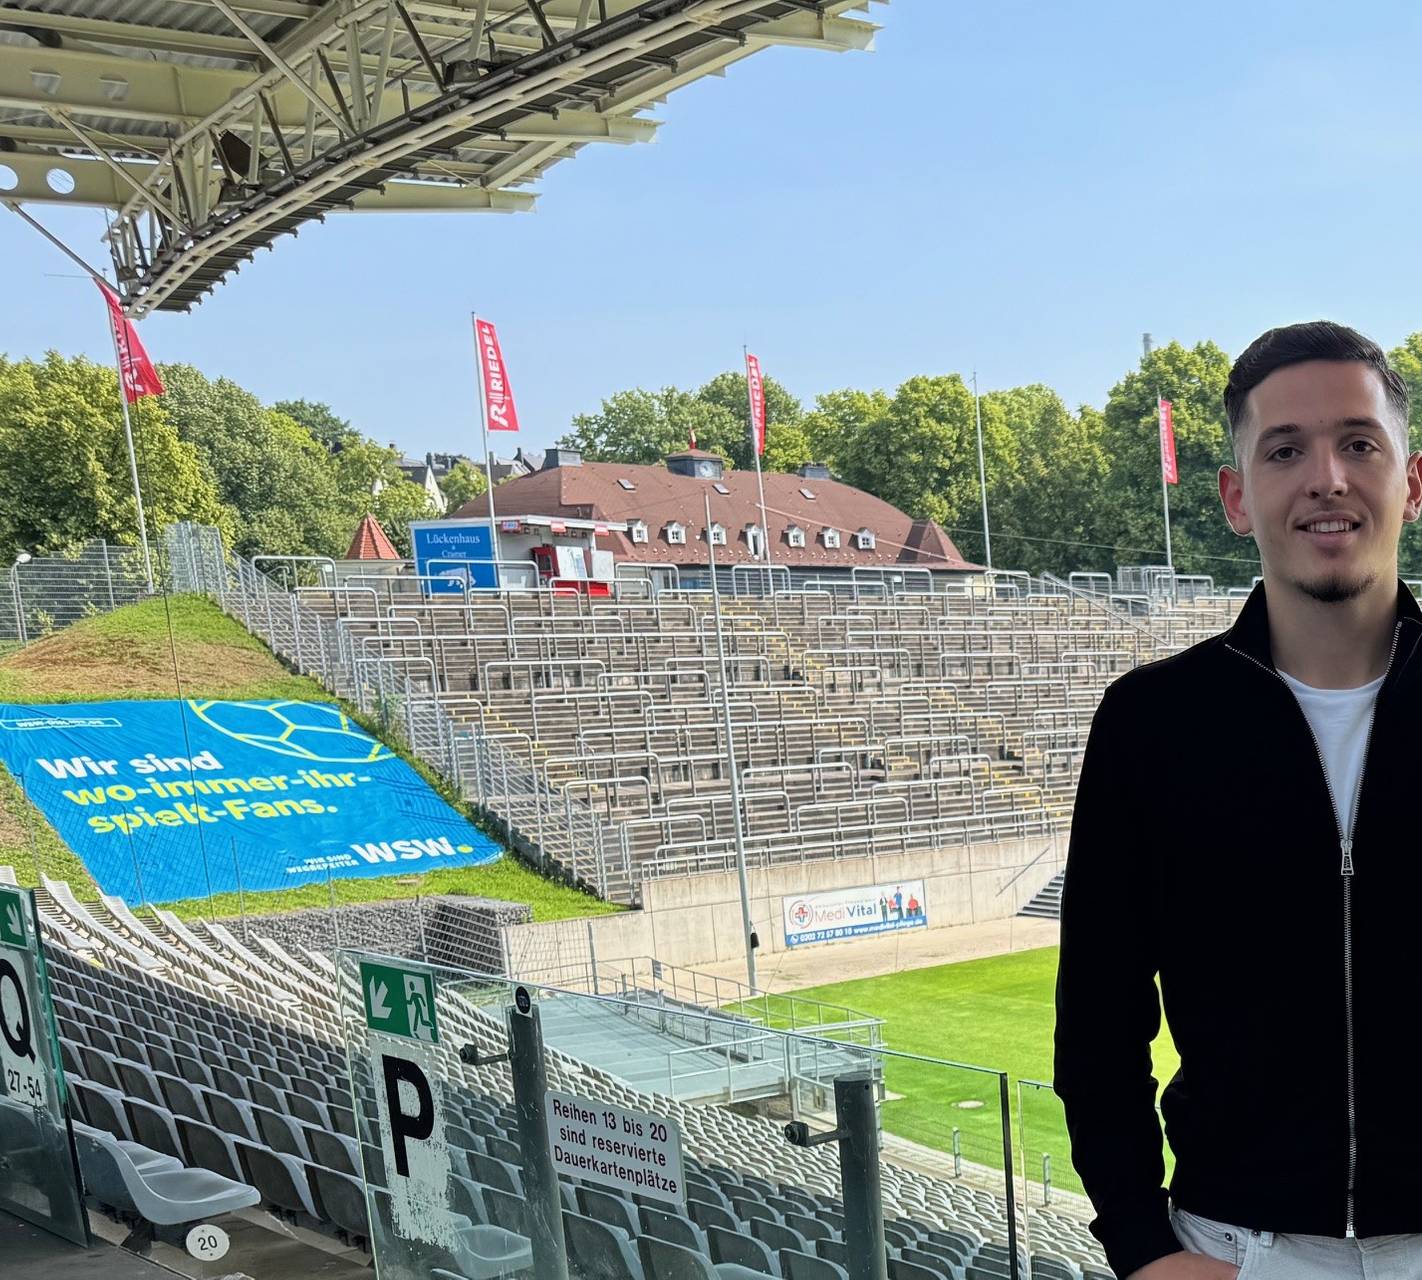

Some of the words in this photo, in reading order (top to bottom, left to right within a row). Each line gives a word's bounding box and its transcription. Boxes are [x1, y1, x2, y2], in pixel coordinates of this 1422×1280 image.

[35, 755, 119, 780] Wir
[129, 750, 225, 774] sind
[62, 769, 372, 806] wo-immer-ihr-
[87, 798, 339, 836] spielt-Fans.
[847, 903, 877, 918] Vital
[0, 958, 37, 1065] Q
[381, 1053, 435, 1178] P
[553, 1099, 597, 1126] Reihen
[602, 1111, 617, 1130] 13
[622, 1115, 643, 1137] bis
[650, 1122, 667, 1143] 20
[560, 1125, 586, 1146] sind
[592, 1135, 666, 1167] reservierte
[554, 1145, 678, 1194] Dauerkartenplätze
[198, 1235, 218, 1251] 20
